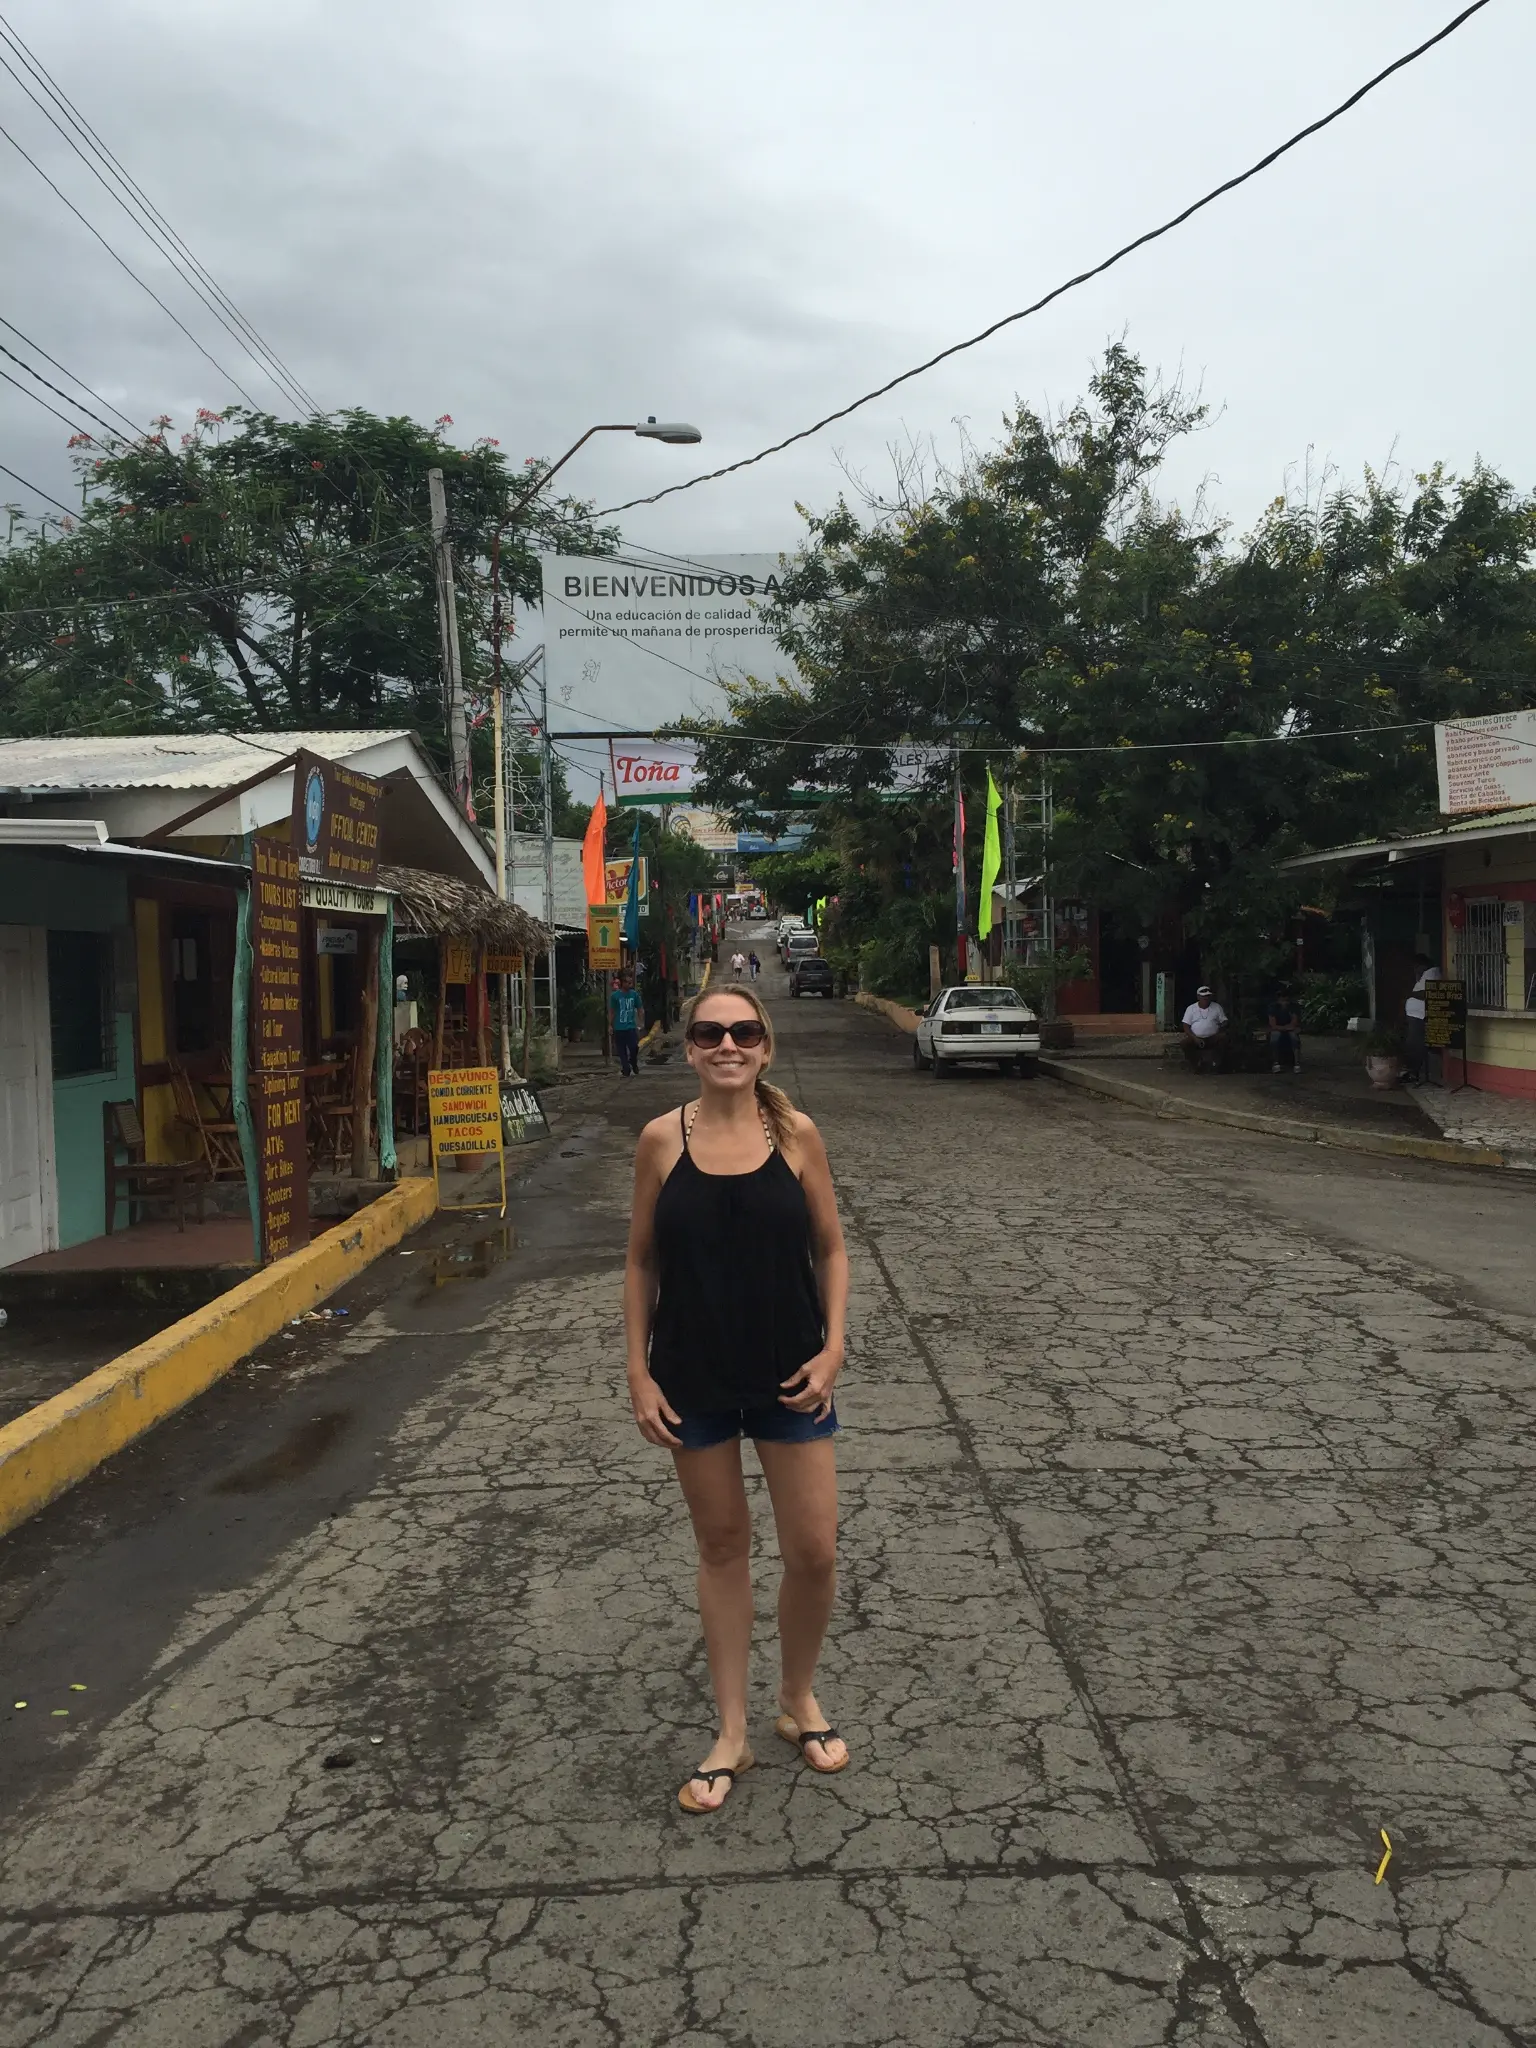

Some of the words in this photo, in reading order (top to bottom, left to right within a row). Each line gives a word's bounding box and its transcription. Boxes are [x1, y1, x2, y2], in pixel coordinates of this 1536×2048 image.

[564, 574, 755, 597] BIENVENIDOS
[586, 609, 612, 621] Una
[615, 608, 681, 621] educación
[685, 608, 700, 620] de
[704, 608, 751, 620] calidad
[559, 626, 608, 639] permite
[612, 628, 628, 637] un
[631, 626, 681, 637] mañana
[685, 626, 700, 636] de
[704, 623, 782, 638] prosperidad
[616, 756, 680, 783] Toña
[356, 821, 377, 848] CENTER
[606, 878, 628, 890] Victor
[259, 881, 281, 907] TOURS
[282, 886, 296, 910] LIST
[316, 886, 349, 908] QUALITY
[352, 891, 375, 911] TOURS
[429, 1070, 496, 1084] DESAYUNOS
[431, 1087, 454, 1098] COMIDA
[456, 1084, 492, 1096] CORRIENTE
[442, 1100, 487, 1112] SANDWICH
[267, 1103, 281, 1129] FOR
[284, 1098, 300, 1125] RENT
[433, 1112, 498, 1125] HAMBURGUESAS
[446, 1126, 483, 1137] TACOS
[439, 1139, 497, 1152] QUESADILLAS
